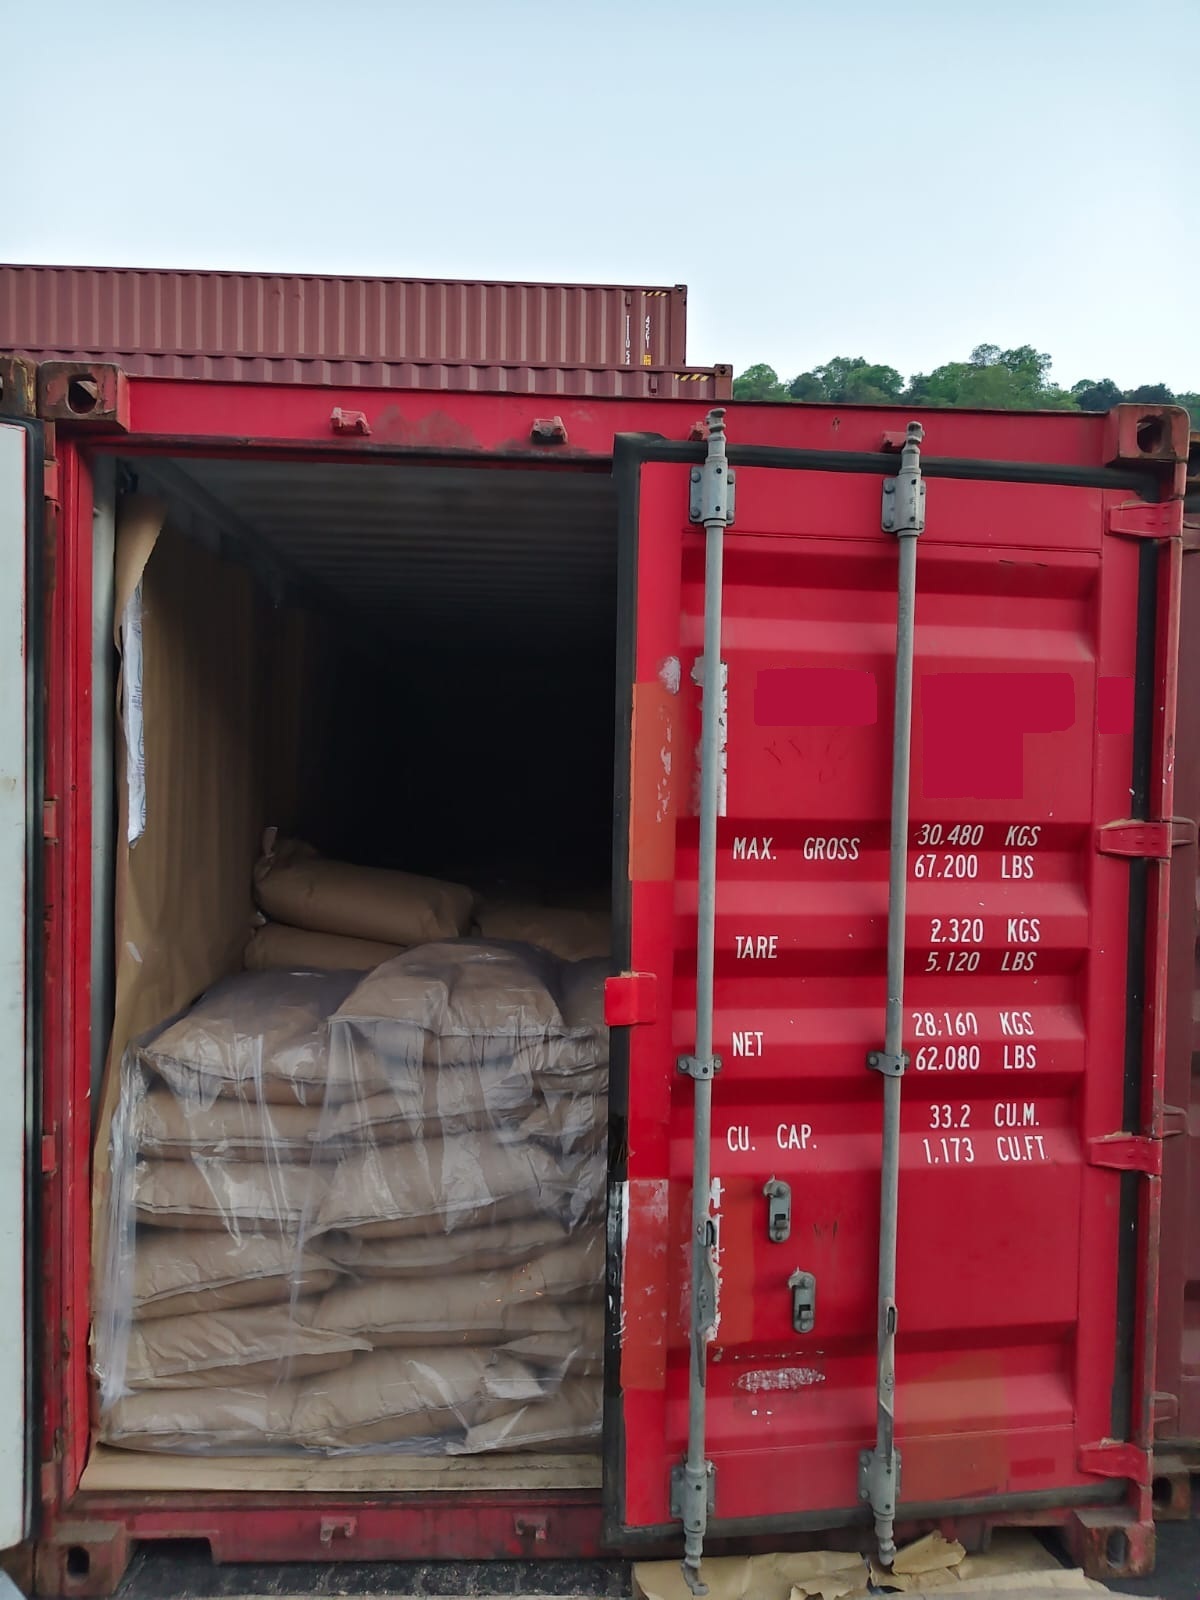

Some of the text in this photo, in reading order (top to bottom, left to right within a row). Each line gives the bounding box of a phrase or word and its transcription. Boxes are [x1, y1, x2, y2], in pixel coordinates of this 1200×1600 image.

[916, 824, 1041, 846] 30,480 KGS
[733, 837, 860, 860] MAX. GROSS
[915, 854, 1033, 879] 67,200 LBS
[931, 919, 1040, 942] 2,320 KGS
[736, 936, 778, 958] TARE
[925, 952, 1037, 971] 5,120 LBS
[1000, 1012, 1034, 1035] KGS
[733, 1032, 763, 1056] NET
[916, 1045, 1036, 1070] 62,080 LBS
[930, 1103, 1039, 1128] 33.2 CU.M.
[727, 1124, 816, 1151] CU. CAP.
[923, 1137, 974, 1163] 1,173
